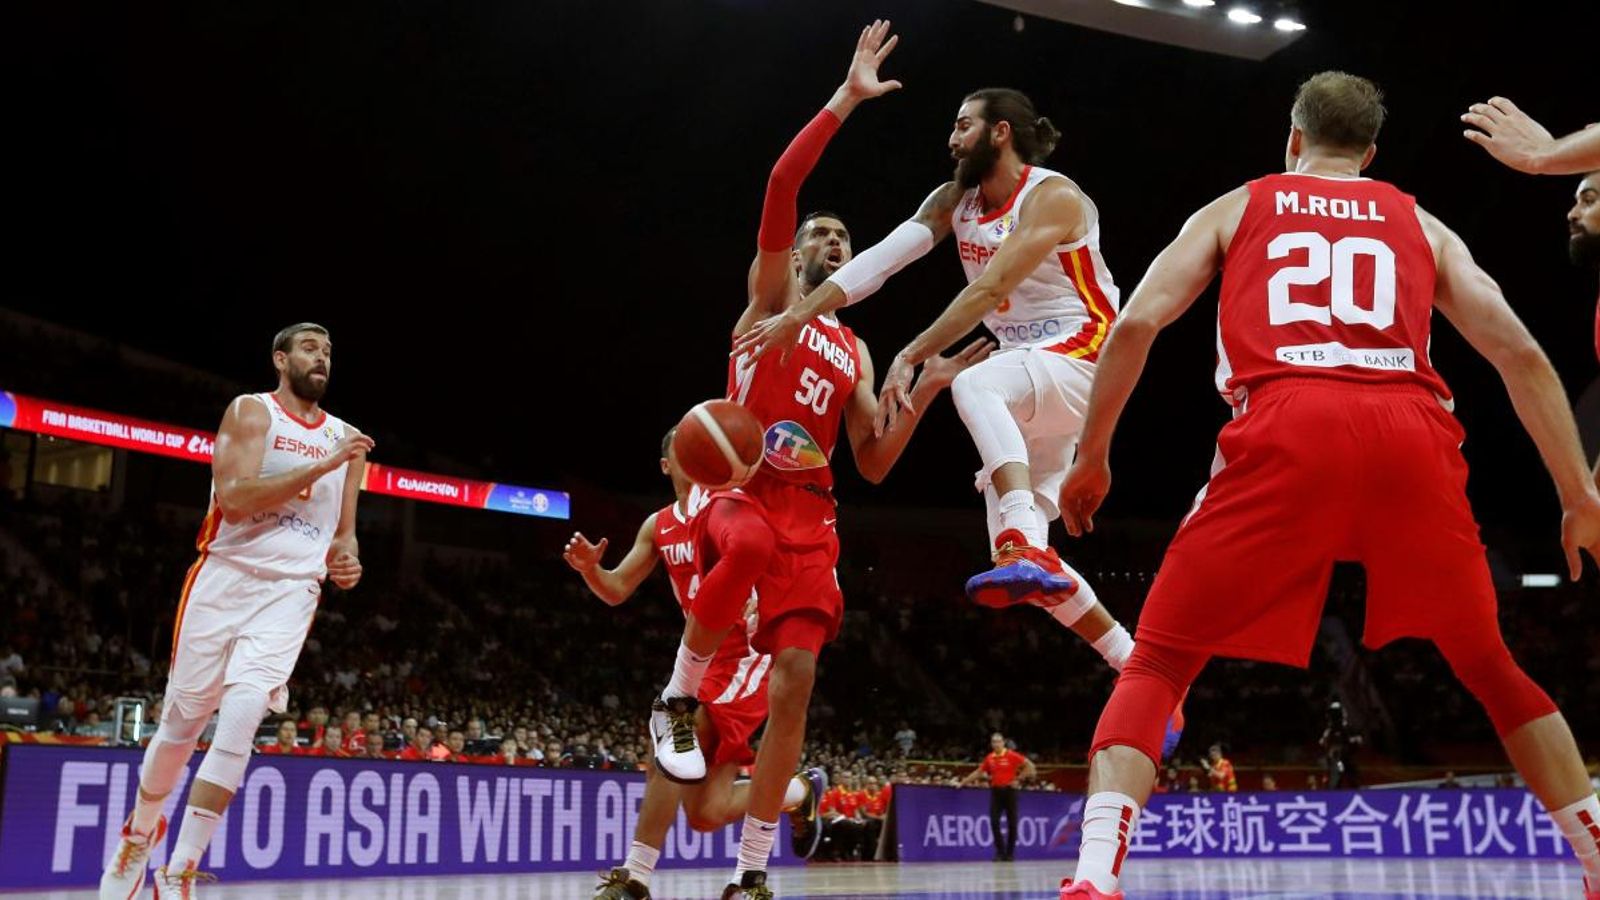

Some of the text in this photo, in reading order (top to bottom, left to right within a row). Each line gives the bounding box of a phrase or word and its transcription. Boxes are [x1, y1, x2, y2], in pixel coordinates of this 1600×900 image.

[1275, 191, 1385, 222] M.ROLL
[1267, 231, 1396, 330] 20
[1283, 350, 1408, 369] STB BANK
[794, 366, 834, 416] 50
[42, 409, 67, 424] FIBA
[68, 414, 130, 440] BASKETBALL
[130, 422, 164, 445] WORLD
[165, 433, 186, 449] CUP
[774, 427, 809, 459] TT
[303, 768, 442, 867] ASIA
[456, 775, 582, 863] WITH
[923, 814, 1049, 848] AEROOT
